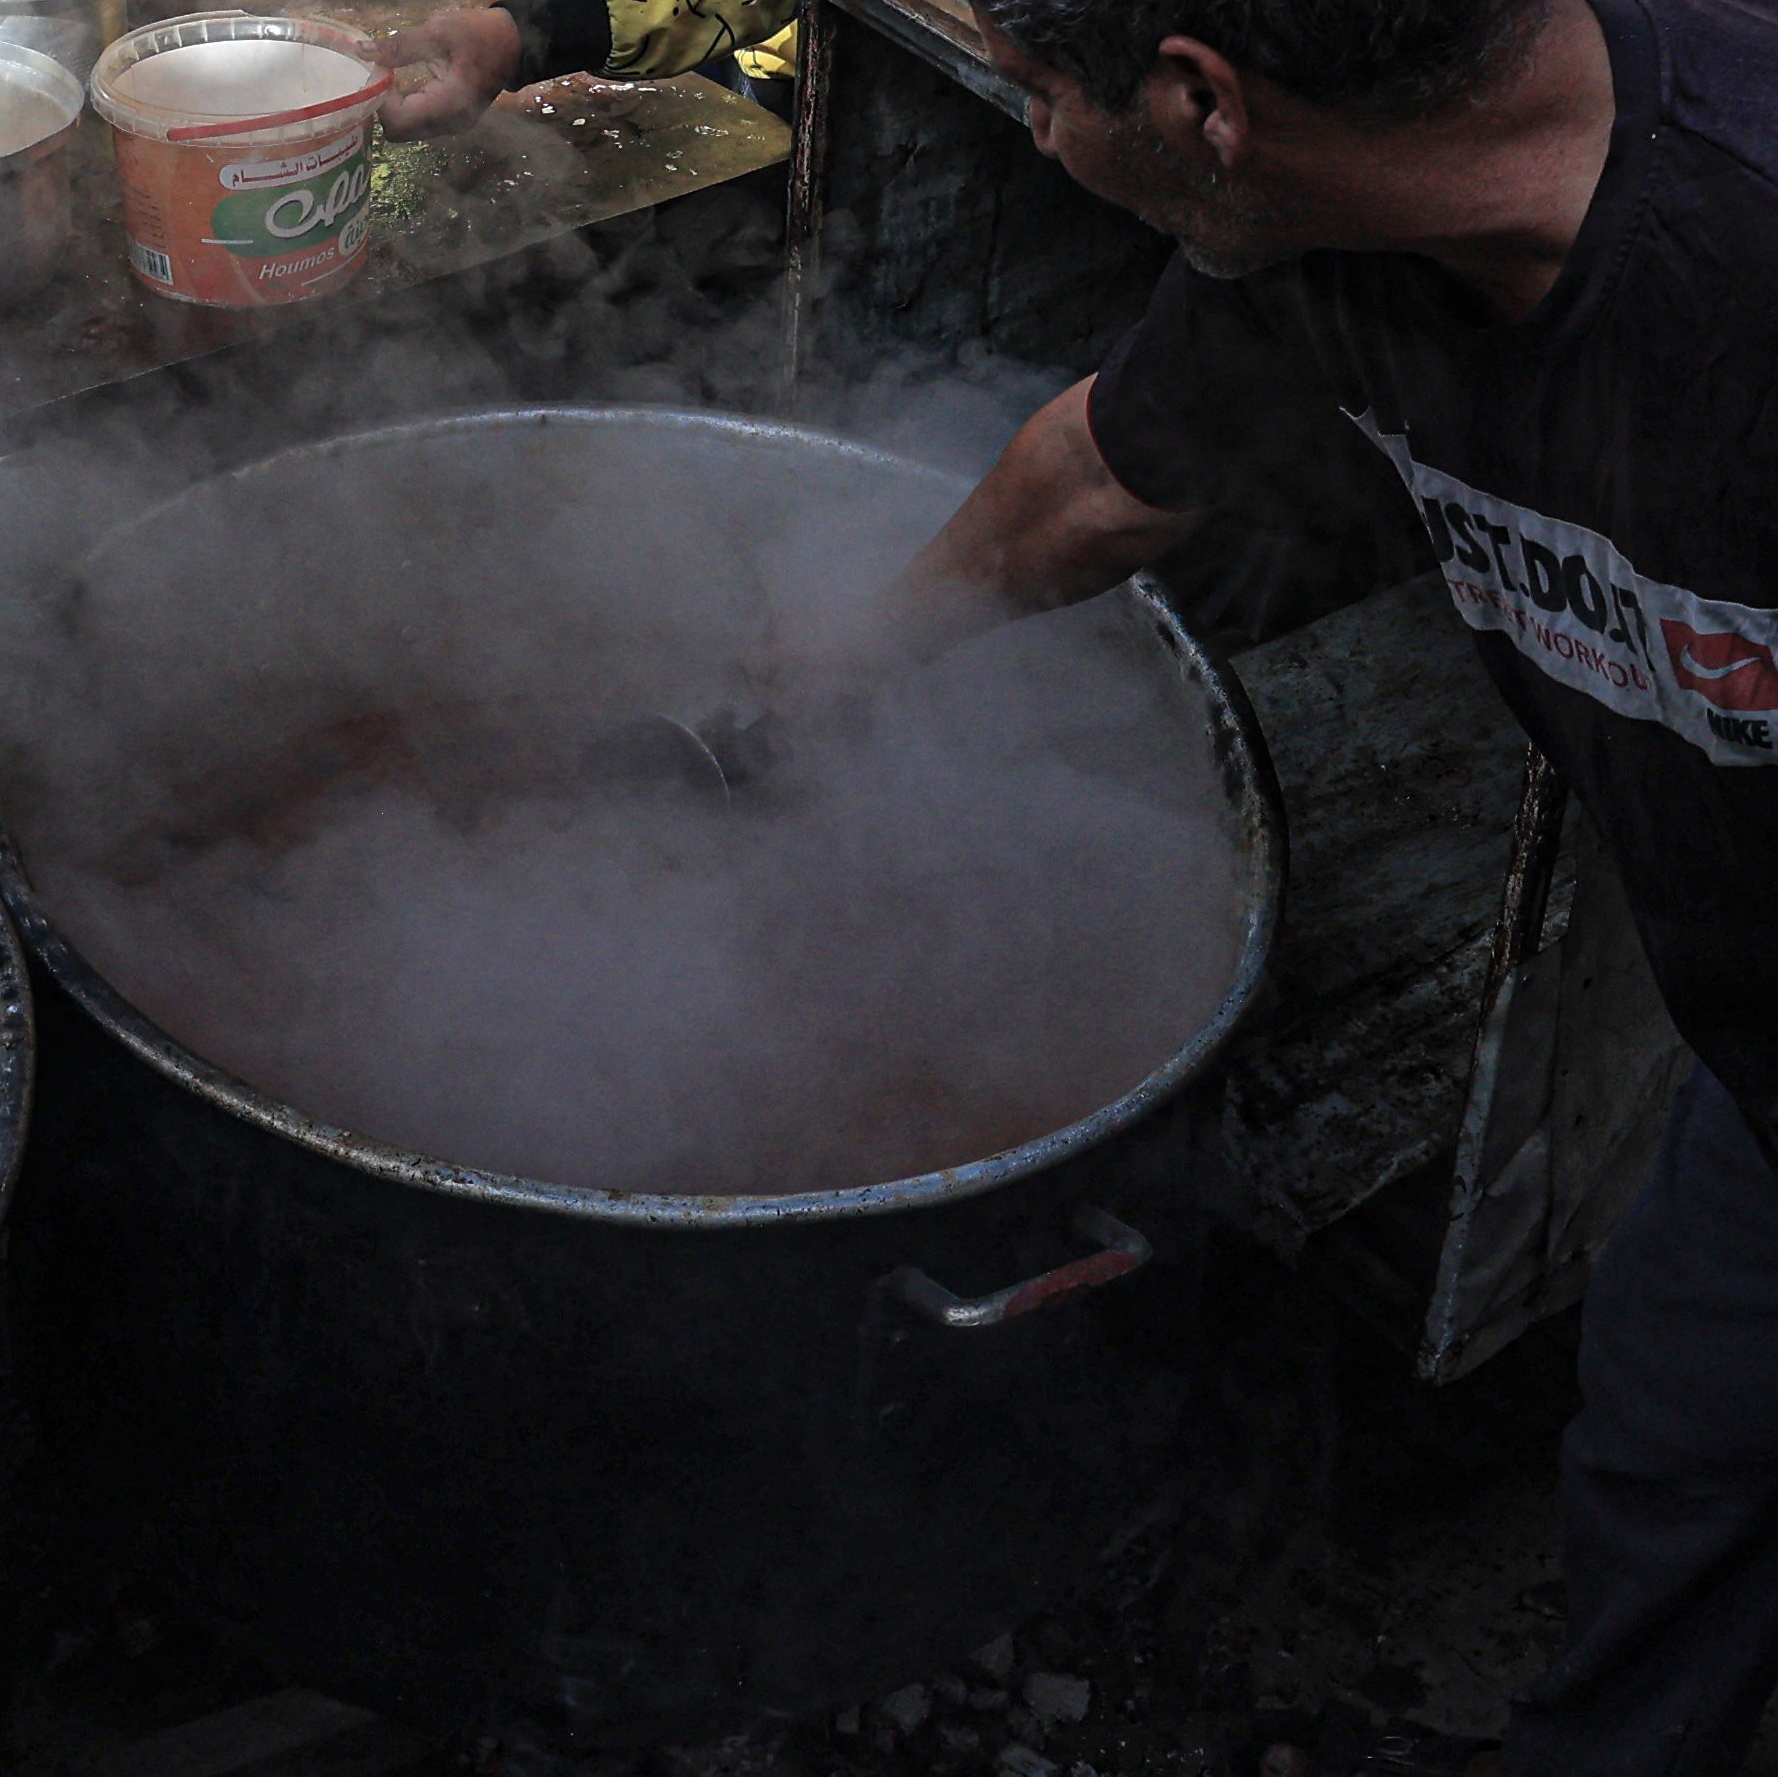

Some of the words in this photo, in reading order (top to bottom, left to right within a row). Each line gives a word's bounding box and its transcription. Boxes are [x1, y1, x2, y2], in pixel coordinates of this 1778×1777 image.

[231, 156, 303, 188] الشام
[258, 245, 335, 280] Houmos
[1706, 708, 1774, 750] NIKE
